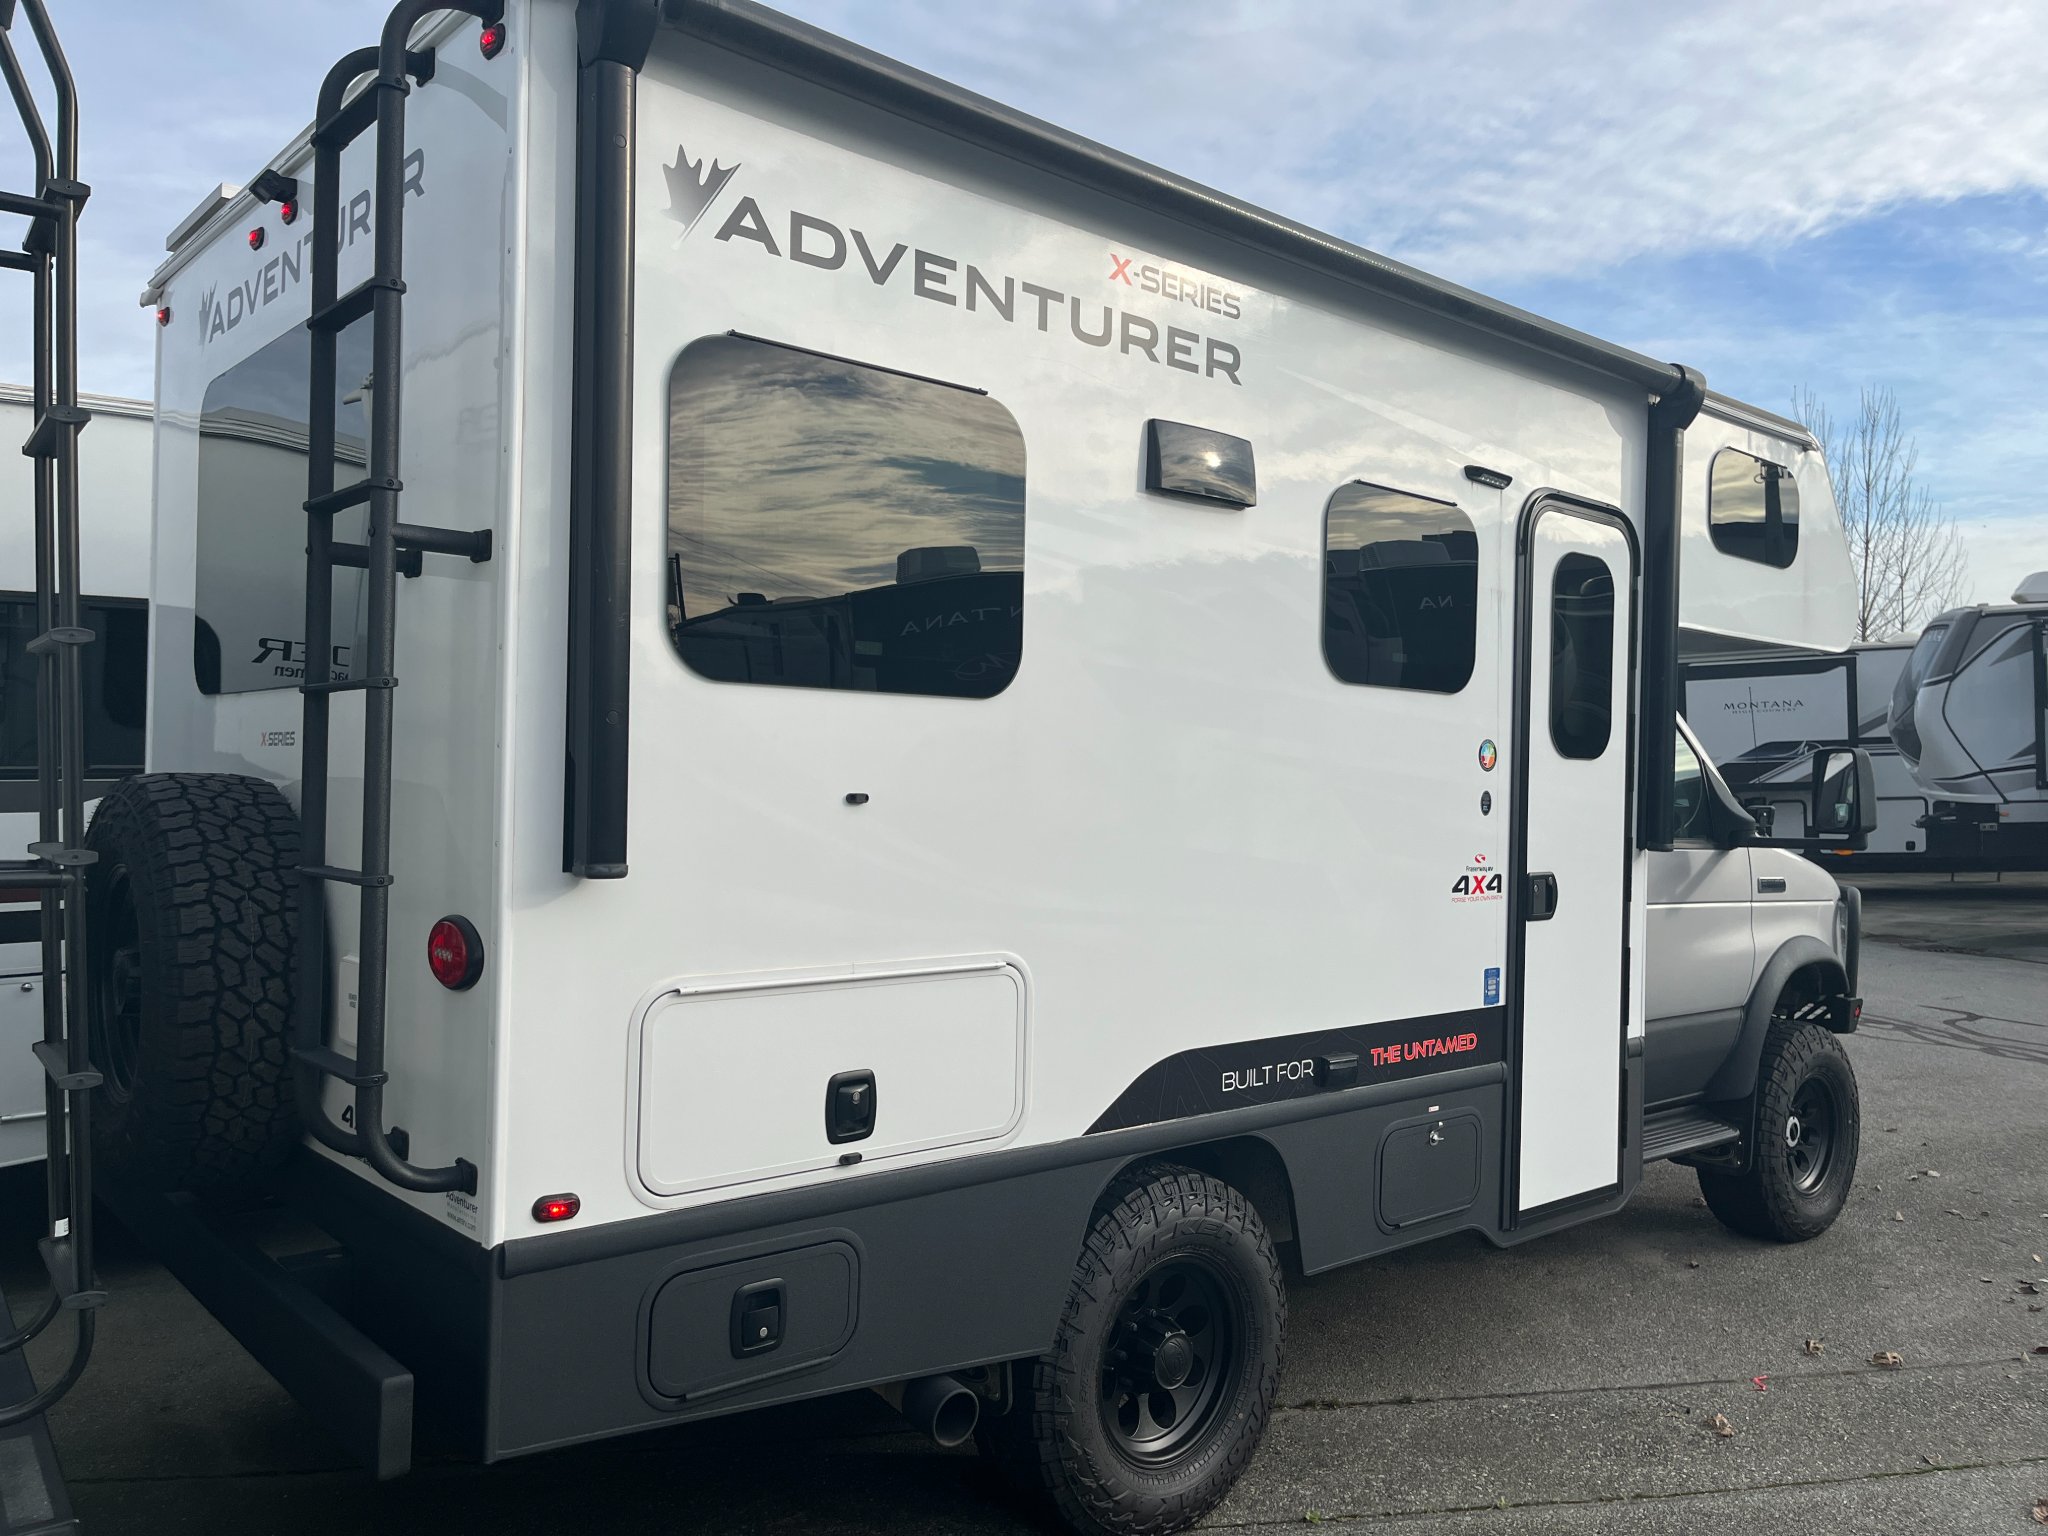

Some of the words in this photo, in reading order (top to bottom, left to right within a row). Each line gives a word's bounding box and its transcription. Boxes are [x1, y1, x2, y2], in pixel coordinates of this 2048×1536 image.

[209, 148, 425, 343] ADVENURR
[714, 196, 1243, 386] ADVENTURER
[1109, 253, 1241, 320] X-SERIES
[1724, 700, 1804, 710] MONTANA
[261, 731, 296, 747] X-SERIES
[1452, 874, 1502, 895] 4X4
[1371, 1045, 1402, 1067] THE
[1404, 1033, 1478, 1061] UNTAMED
[1222, 1066, 1272, 1092] BUILT
[1277, 1059, 1314, 1082] FOR
